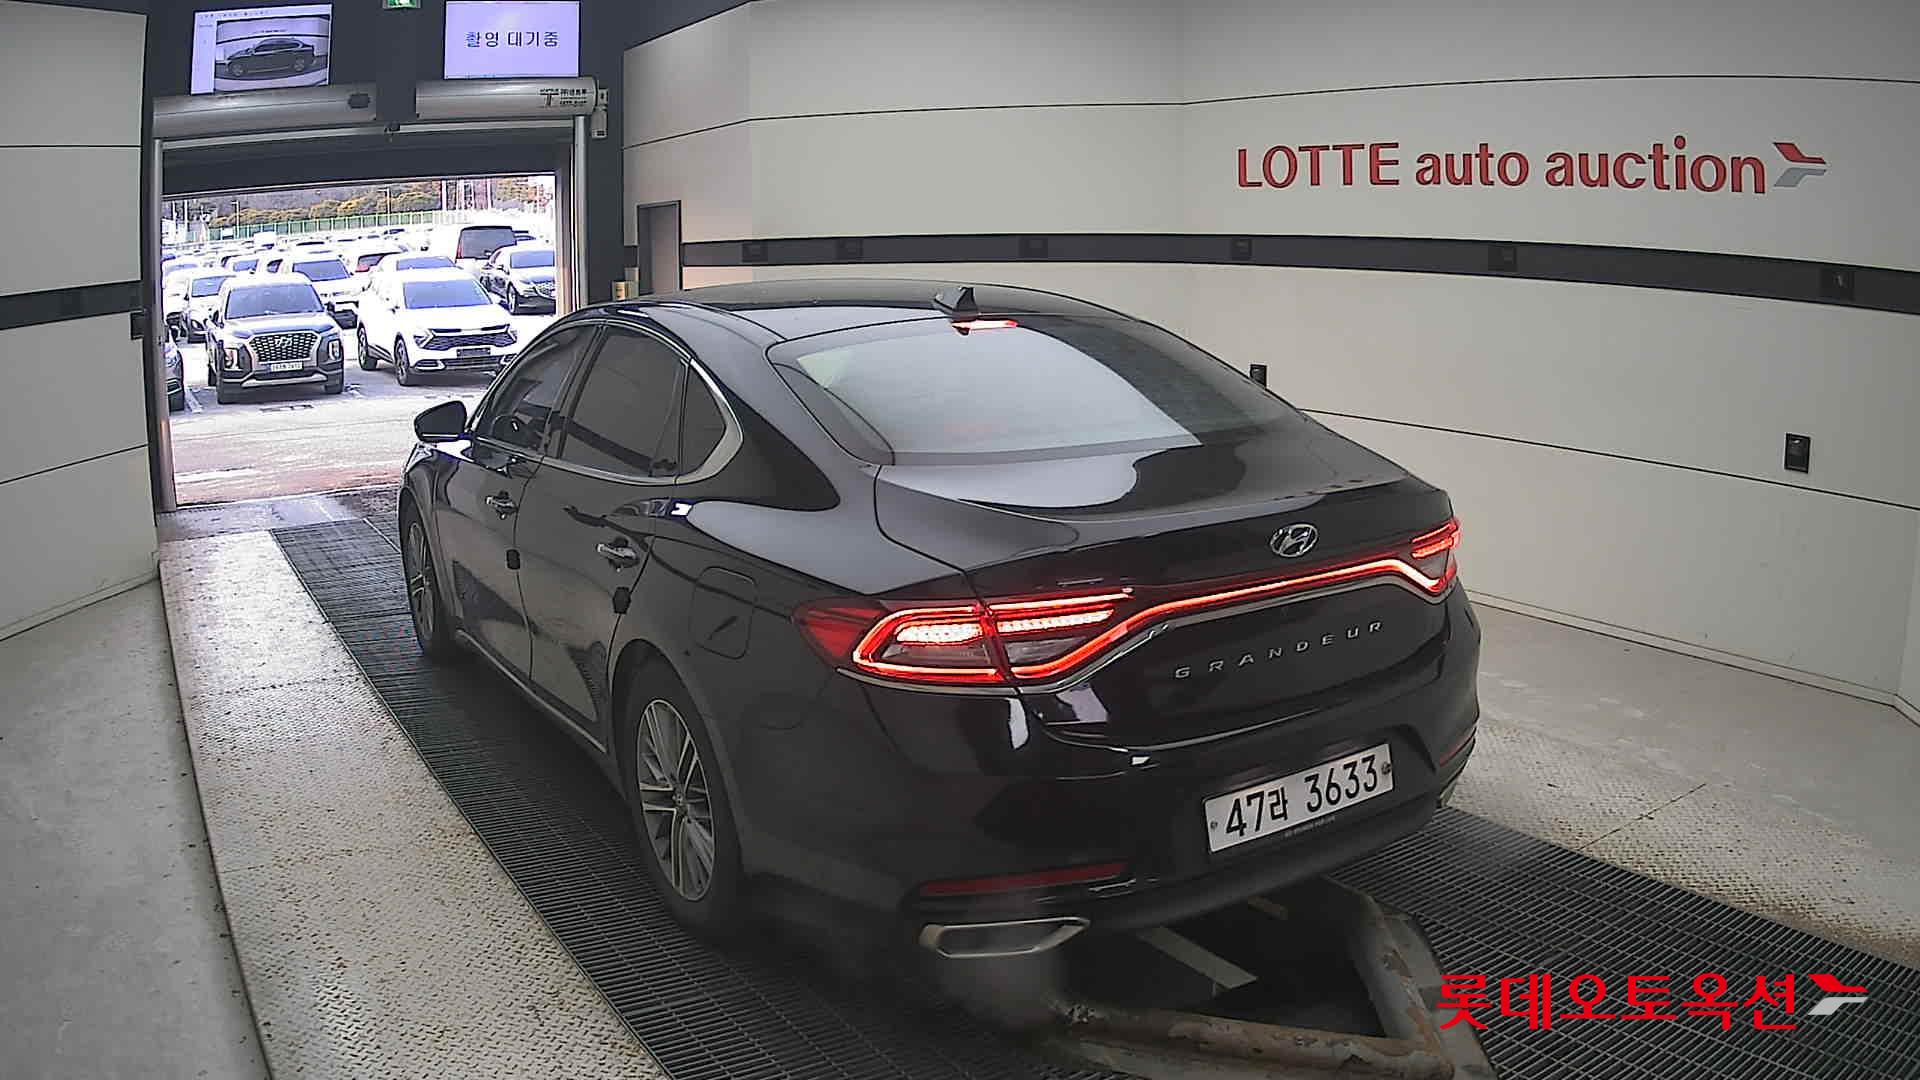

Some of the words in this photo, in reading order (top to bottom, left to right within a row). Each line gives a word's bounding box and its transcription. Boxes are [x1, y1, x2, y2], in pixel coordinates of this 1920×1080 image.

[507, 31, 558, 48] 대기중
[1236, 142, 1400, 188] LOTTE
[1415, 143, 1529, 187] auto
[1545, 135, 1766, 194] auction
[1174, 621, 1383, 679] GRANDEUR
[1225, 786, 1289, 837] 47라
[1304, 754, 1379, 813] 3633
